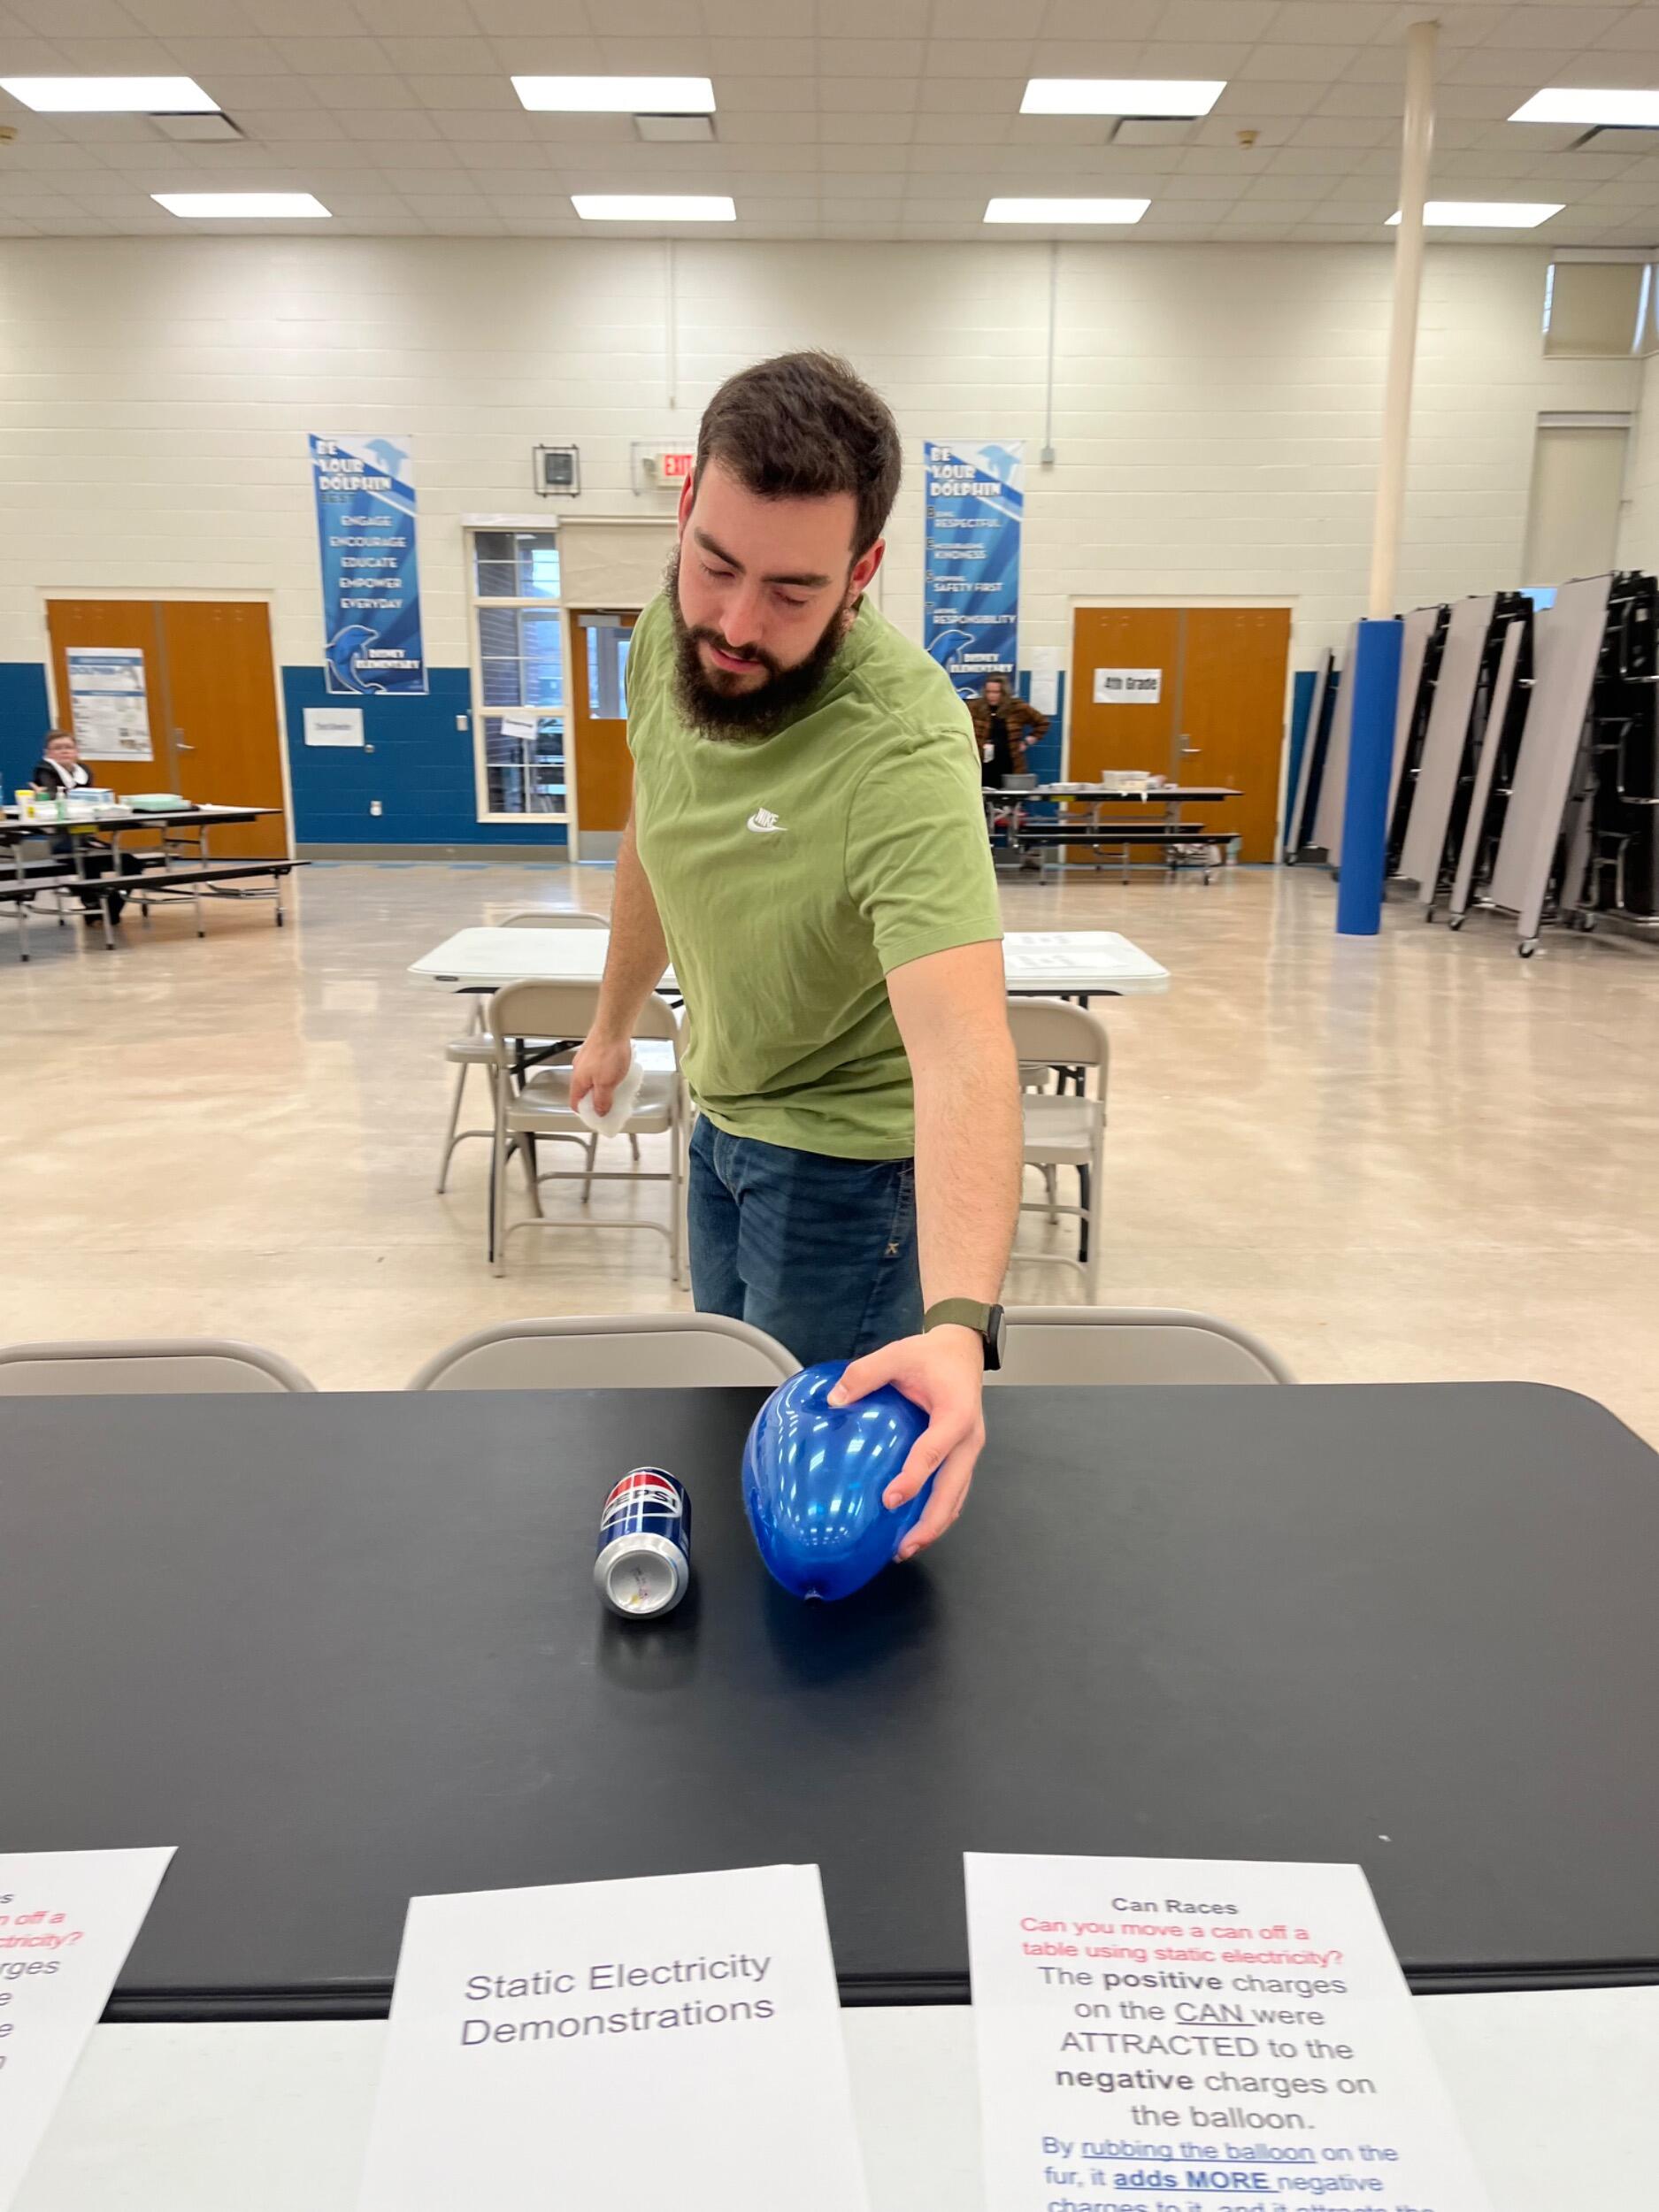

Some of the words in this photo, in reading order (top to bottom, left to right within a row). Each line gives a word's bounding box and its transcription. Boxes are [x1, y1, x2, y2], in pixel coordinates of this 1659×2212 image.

[319, 459, 364, 473] YOUR
[664, 454, 693, 476] EXIT
[930, 447, 952, 461] BE
[319, 476, 392, 491] DOLPHIN
[932, 465, 976, 479] YOUR
[930, 482, 1002, 496] DOLPHIN
[1111, 1898, 1158, 1912] Can
[1165, 1900, 1239, 1915] Races
[1019, 1917, 1066, 1932] Can
[1071, 1921, 1114, 1936] you
[1121, 1924, 1184, 1938] move
[1189, 1925, 1205, 1938] a
[1210, 1926, 1253, 1939] can
[1258, 1924, 1287, 1939] off
[1294, 1927, 1310, 1940] a
[1022, 1942, 1079, 1957] table
[1086, 1944, 1148, 1962] using
[1155, 1946, 1216, 1962] static
[1221, 1948, 1344, 1969] electricity?
[465, 1970, 575, 2001] Static
[588, 1954, 772, 1990] Electricity
[1037, 1966, 1094, 1985] The
[1102, 1971, 1223, 1991] positive
[1232, 1974, 1348, 1999] charges
[460, 1999, 775, 2046] Demonstrations
[1074, 2002, 1111, 2019] on
[1118, 2001, 1166, 2021] the
[1173, 2001, 1245, 2025] CAN
[1252, 2008, 1325, 2025] were
[1061, 2032, 1259, 2058] ATTRACTED
[1268, 2039, 1298, 2059] to
[1305, 2039, 1355, 2060] the
[1056, 2070, 1195, 2093] negative
[1204, 2071, 1328, 2099] charges
[1337, 2078, 1378, 2094] on
[1131, 2104, 1181, 2127] the
[1189, 2105, 1316, 2130] balloon.
[1042, 2136, 1074, 2159] By
[1082, 2139, 1174, 2162] rubbing
[1179, 2141, 1218, 2159] the
[1225, 2142, 1316, 2161] balloon
[1321, 2147, 1355, 2162] on
[1358, 2144, 1399, 2162] the
[1044, 2166, 1084, 2187] fur,
[1090, 2167, 1107, 2186] it
[1113, 2169, 1179, 2189] adds
[1186, 2170, 1270, 2191] MORE
[1277, 2173, 1385, 2195] negative
